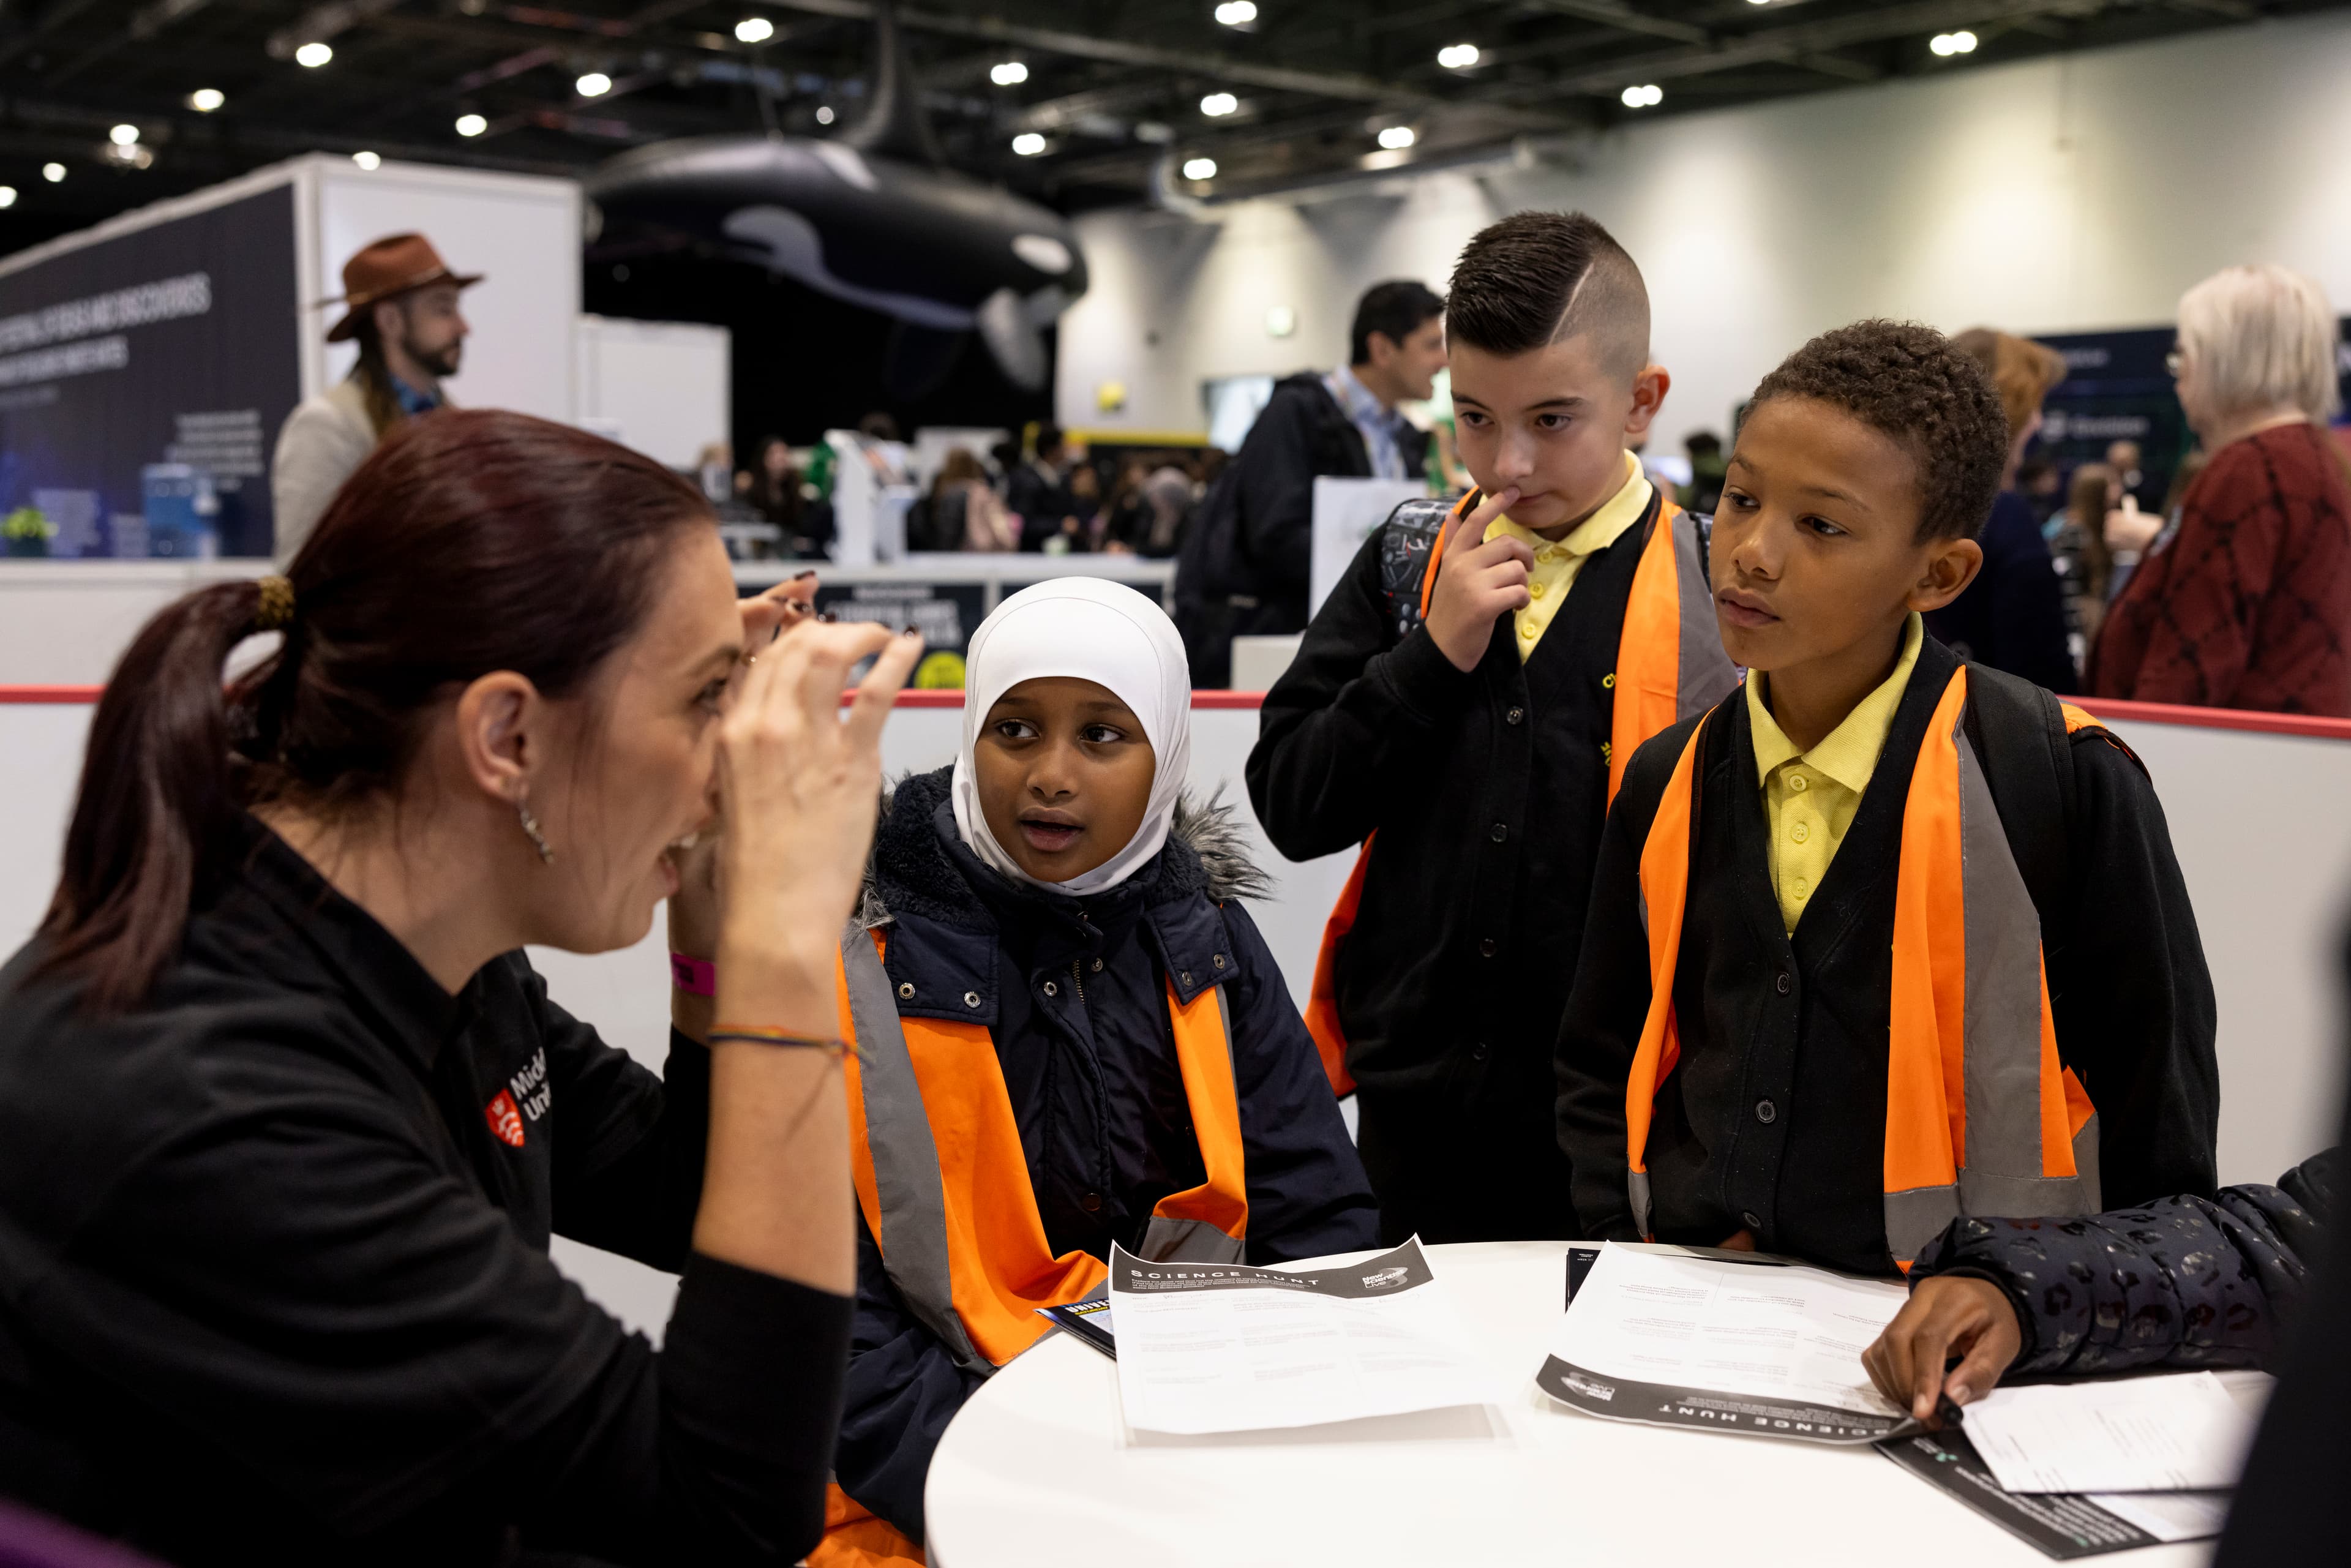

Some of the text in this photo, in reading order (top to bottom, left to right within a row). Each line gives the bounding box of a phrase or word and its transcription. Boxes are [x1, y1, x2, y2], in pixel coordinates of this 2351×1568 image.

[1131, 1269, 1241, 1279] SCIENCE
[1255, 1273, 1319, 1285] HUNT
[1362, 1273, 1383, 1281] New
[1658, 1403, 1738, 1422] HUNT
